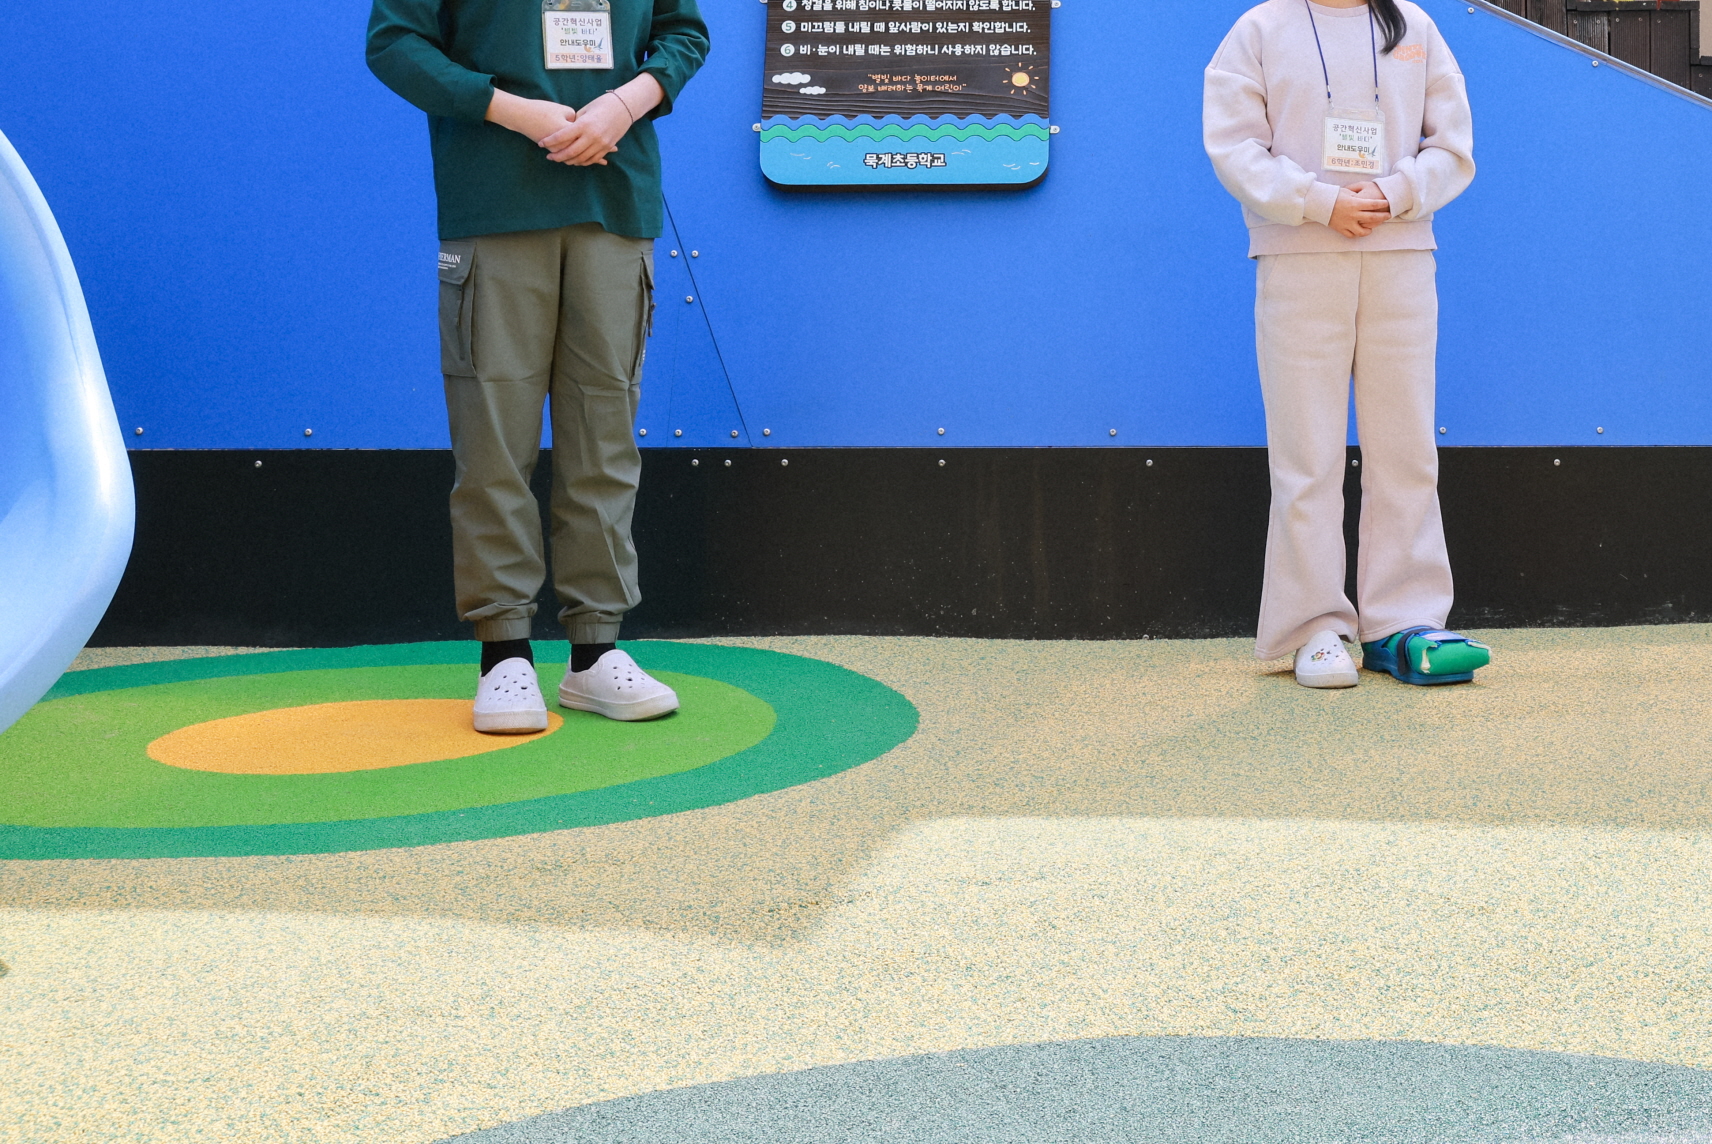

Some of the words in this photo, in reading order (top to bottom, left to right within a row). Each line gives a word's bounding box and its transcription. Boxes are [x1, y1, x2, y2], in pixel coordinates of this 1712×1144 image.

[802, 0, 833, 10] 청결을
[836, 0, 856, 10] 위해
[858, 0, 890, 10] 침이나
[892, 0, 922, 10] 콧물이
[925, 0, 966, 10] 떨어지지
[969, 0, 1000, 10] 않도록
[1002, 0, 1036, 10] 합니다.
[552, 17, 602, 27] 공간혁신사업
[849, 22, 870, 33] 내릴
[874, 22, 885, 33] 때
[888, 22, 932, 33] 앞사람이
[936, 22, 968, 33] 있는지
[972, 22, 1030, 33] 확인합니다.
[843, 44, 865, 55] 내릴
[868, 44, 891, 55] 때는
[894, 44, 938, 55] 위험하니
[942, 44, 986, 55] 사용하지
[989, 44, 1036, 55] 않습니다.
[914, 74, 957, 84] 놀이터에서
[1332, 124, 1378, 135] 공간혁신사업
[1336, 144, 1370, 153] 안내도우미
[864, 152, 946, 169] 묵계초등학교
